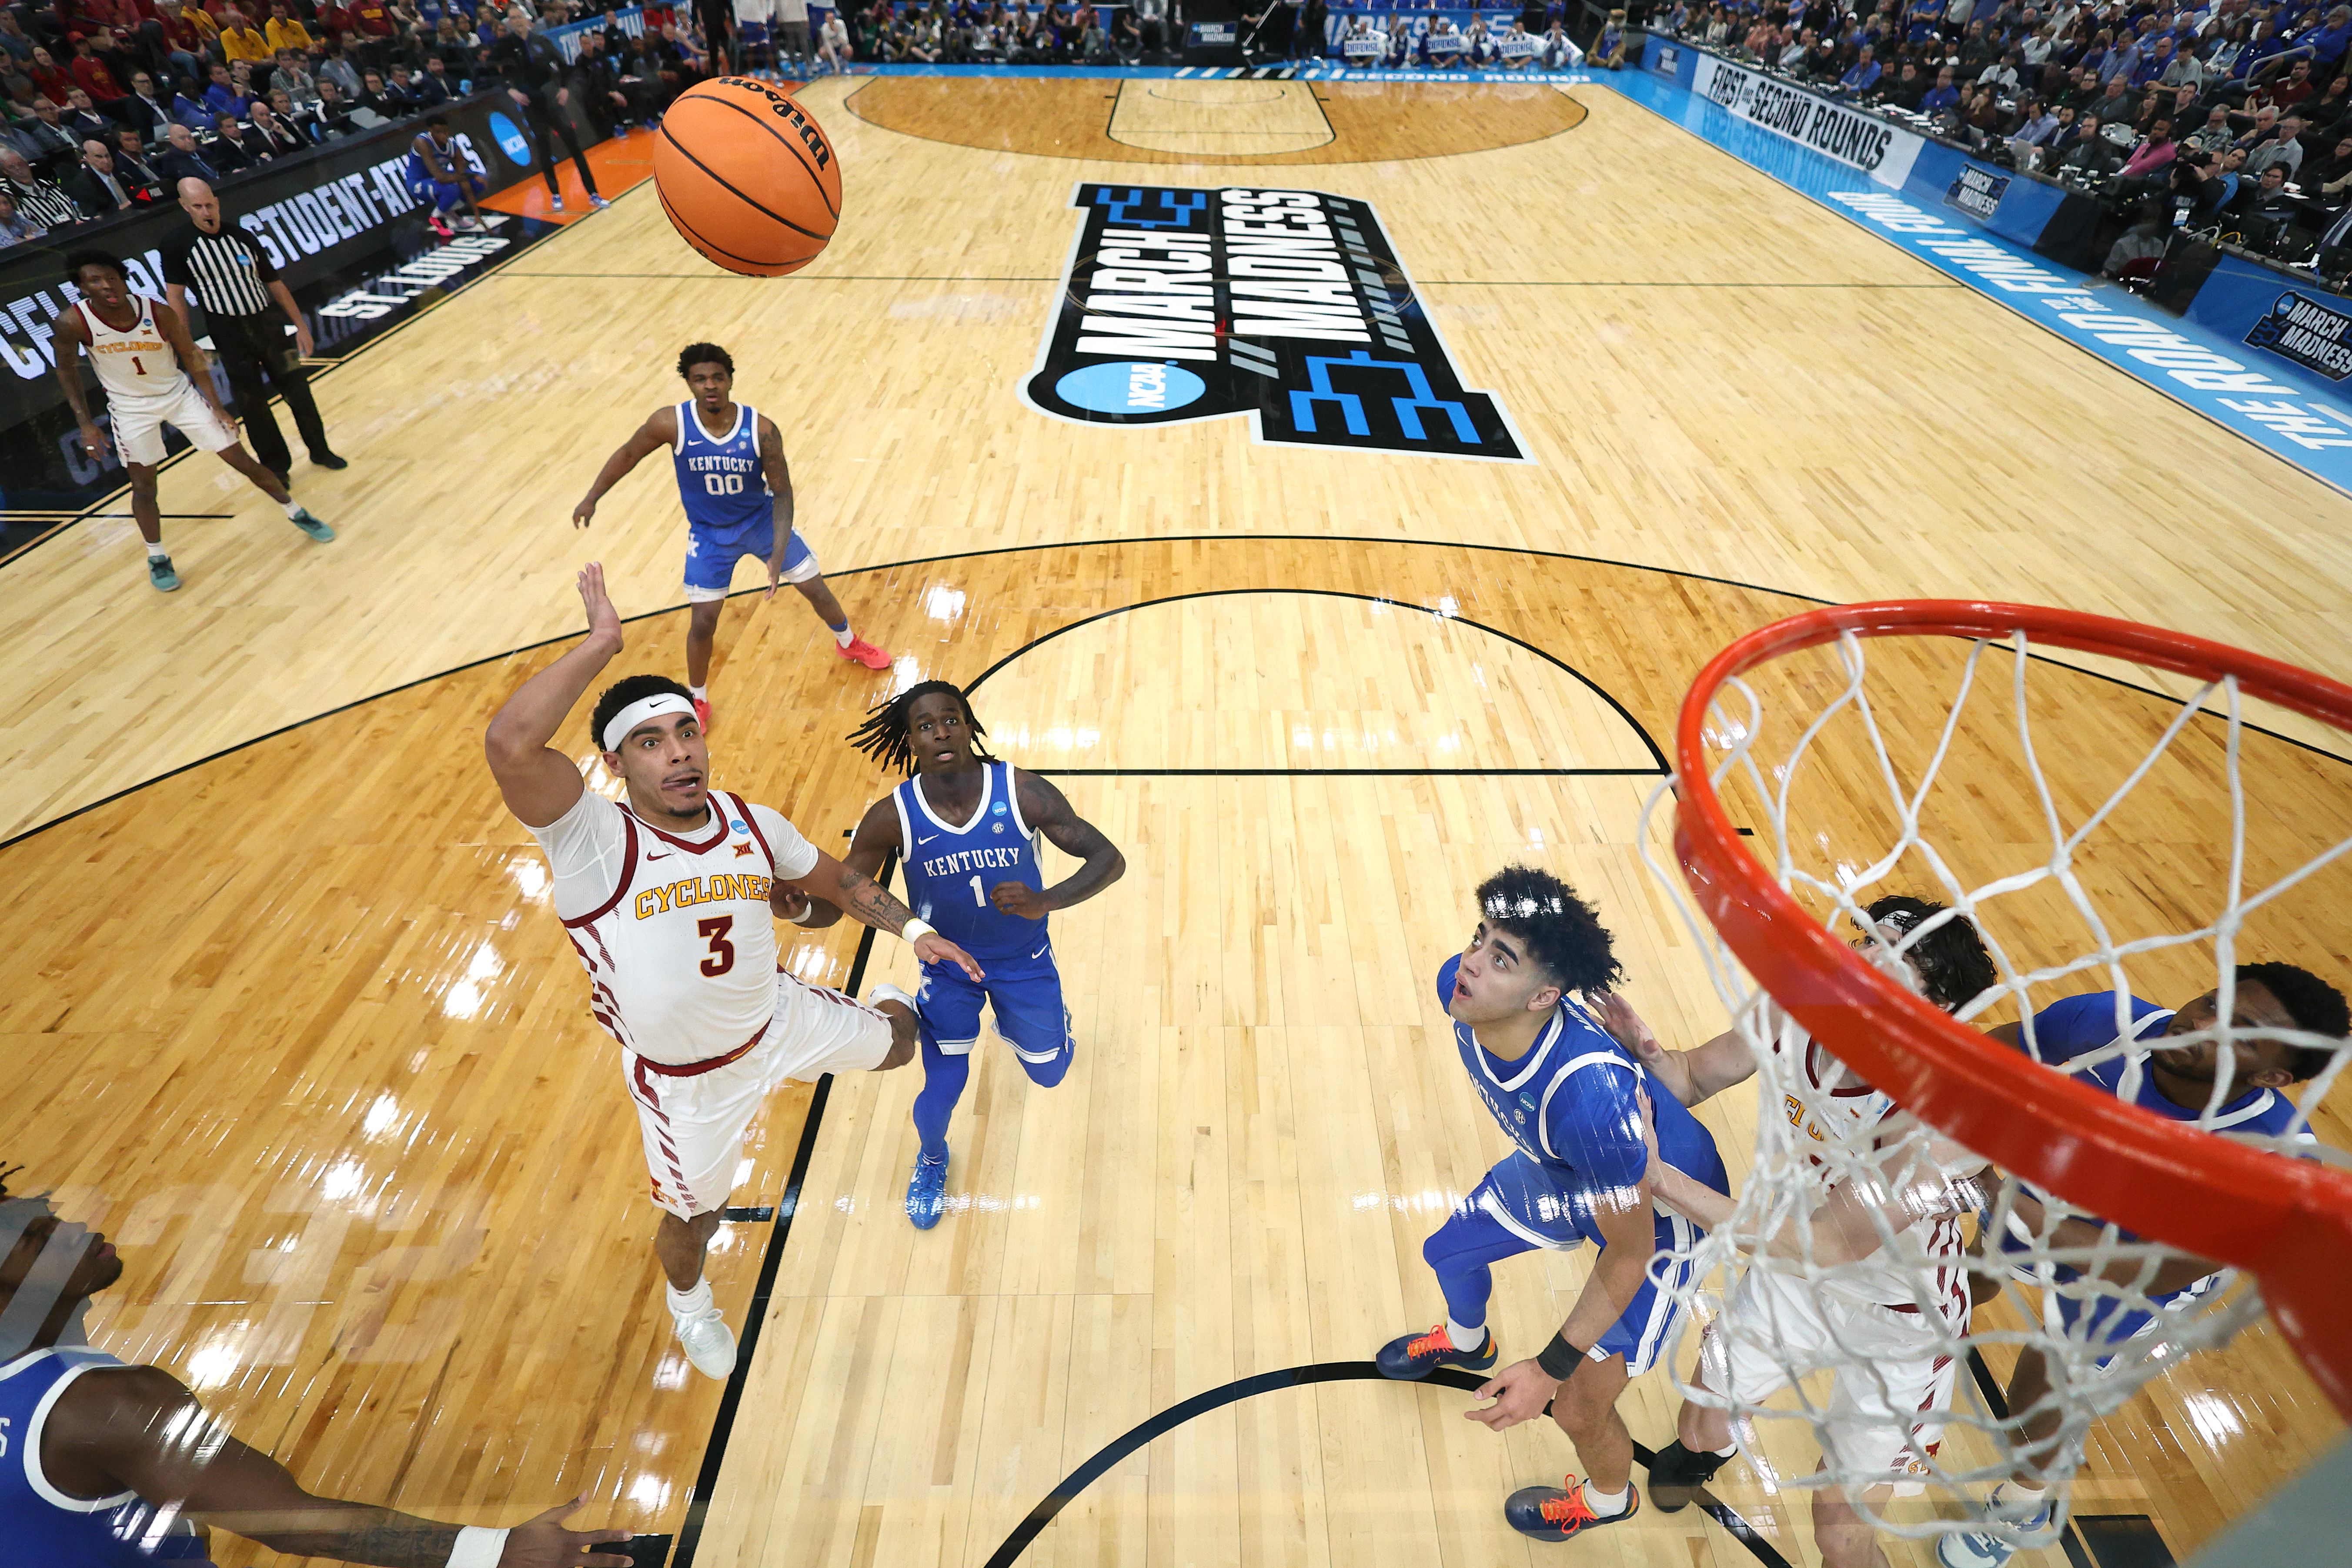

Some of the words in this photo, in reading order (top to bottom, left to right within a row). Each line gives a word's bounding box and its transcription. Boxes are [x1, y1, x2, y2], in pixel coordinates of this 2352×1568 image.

[1707, 64, 1747, 109] FIRST
[1748, 81, 1812, 137] SECOND
[1807, 105, 1892, 171] ROUNDS
[1827, 191, 1968, 235] FOUR
[318, 290, 423, 320] ST.
[378, 236, 511, 285] LOUIS
[1220, 189, 1372, 342] MADNESS
[1916, 238, 2094, 296] FINAL
[1075, 228, 1217, 361] MARCH
[2286, 301, 2349, 341] MARCH
[132, 356, 147, 375] 1
[2058, 312, 2301, 395] ROAD
[1127, 364, 1167, 408] NCAA
[2216, 397, 2352, 450] THE
[688, 455, 754, 472] KENTUCKY
[704, 473, 744, 496] 00
[993, 823, 1003, 833] SEC
[923, 848, 1019, 877] KENTUCKY
[635, 874, 770, 920] CYCLONES
[969, 875, 987, 908] 1
[697, 914, 735, 978] 3
[1515, 1110, 1525, 1124] SEC
[1520, 1098, 1535, 1112] NCAA
